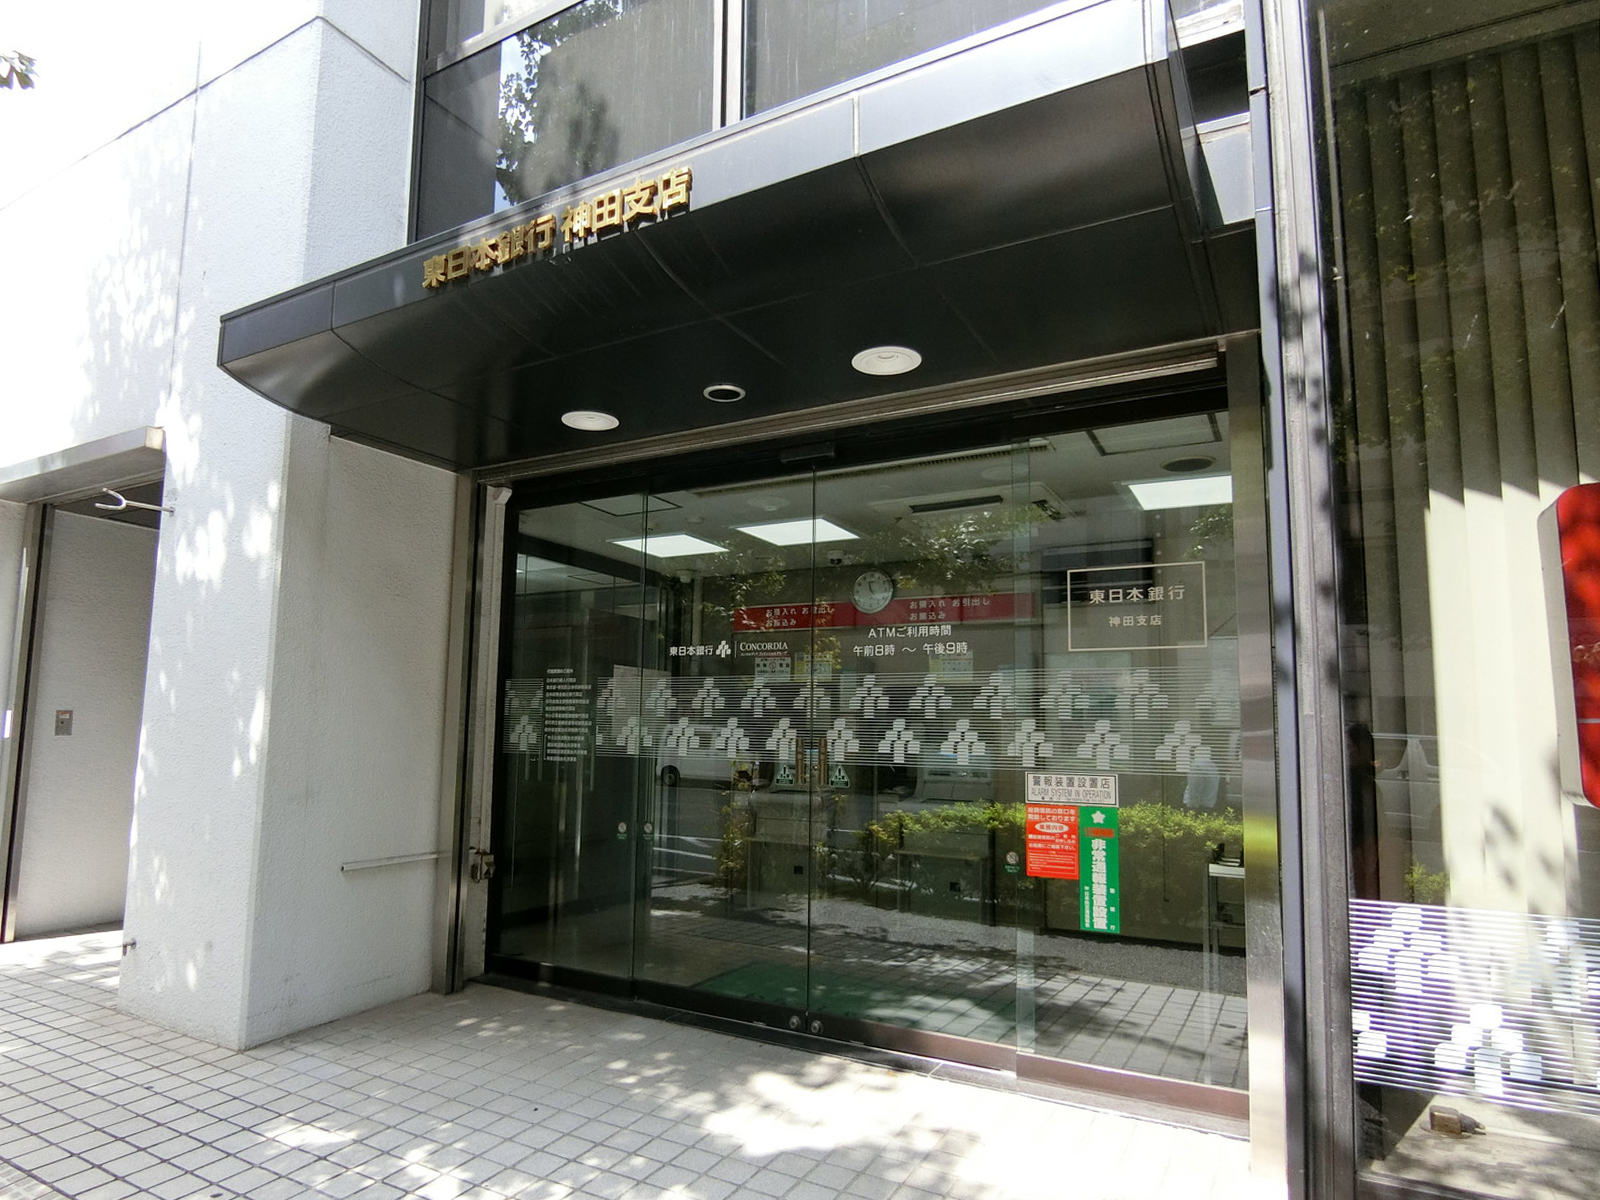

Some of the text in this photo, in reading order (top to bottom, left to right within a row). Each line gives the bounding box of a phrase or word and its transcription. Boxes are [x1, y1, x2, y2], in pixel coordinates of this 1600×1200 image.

[422, 166, 692, 289] 東日本銀行 神田支店
[1089, 584, 1185, 604] 東日本銀行
[1108, 615, 1162, 627] 神田支店
[868, 625, 952, 639] ATMご利用時間
[669, 645, 714, 656] 東日本銀行
[740, 642, 789, 651] CONCORDIA
[853, 644, 895, 657] 午前8時
[923, 642, 968, 655] 午後9時
[1032, 775, 1111, 789] 警報装置設置店
[1031, 788, 1049, 796] ALARM
[1051, 788, 1073, 798] SYSTEM
[1075, 790, 1080, 798] IN
[1082, 790, 1112, 800] OPERATION
